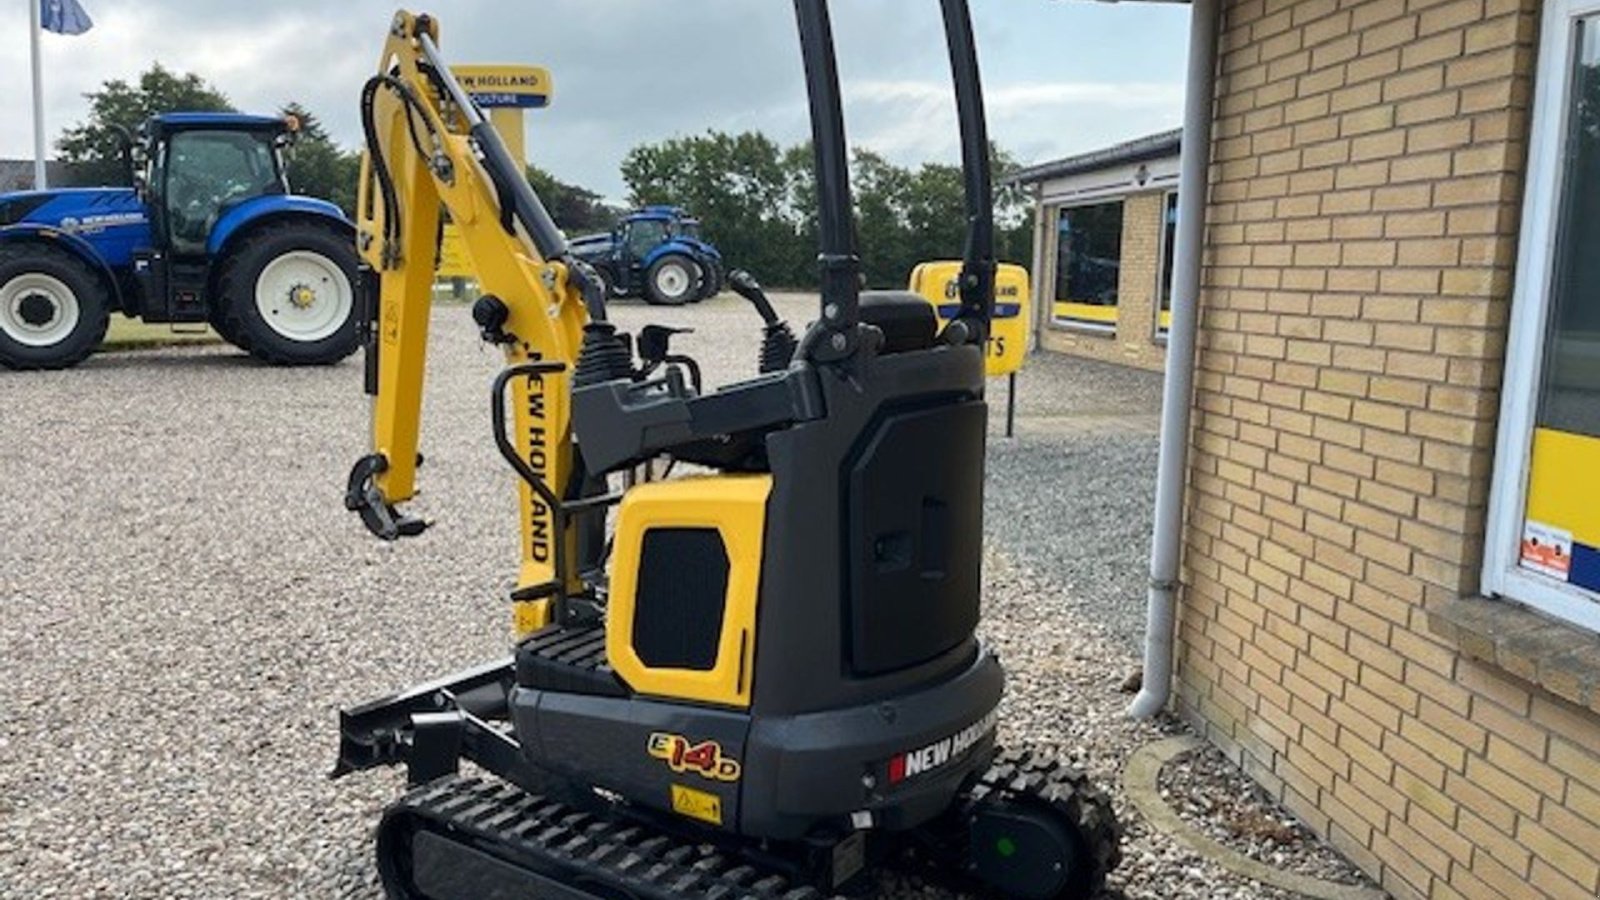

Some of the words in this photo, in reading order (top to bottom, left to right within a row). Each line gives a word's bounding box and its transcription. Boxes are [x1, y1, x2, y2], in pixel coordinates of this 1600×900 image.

[478, 75, 538, 87] HOLLAND
[473, 94, 517, 104] CULTURE
[529, 427, 549, 563] HOAND
[904, 737, 952, 778] NEW
